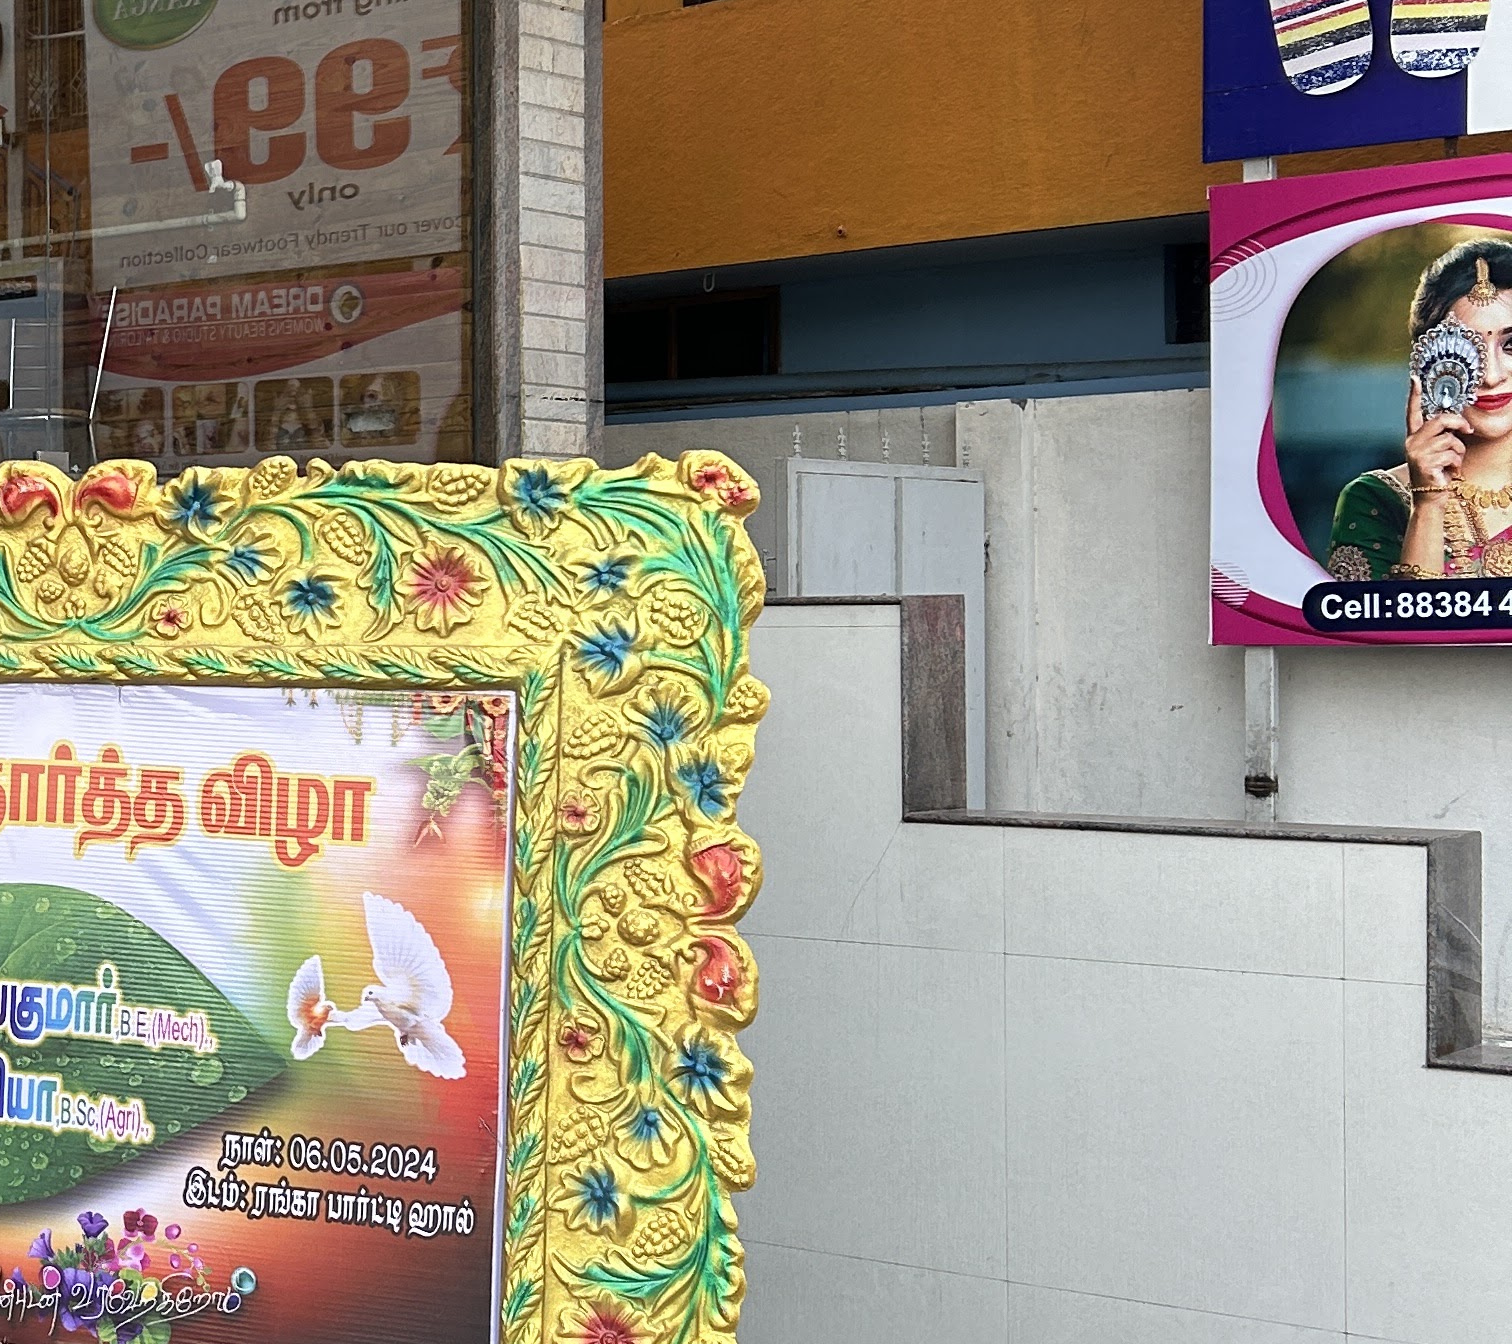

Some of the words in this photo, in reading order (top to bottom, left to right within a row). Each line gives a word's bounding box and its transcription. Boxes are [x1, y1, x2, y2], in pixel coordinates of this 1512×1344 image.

[202, 753, 373, 867] விழா
[290, 1136, 437, 1182] 06.05.2024
[251, 1180, 320, 1217] ரங்கா
[328, 1188, 402, 1233] பார்ட்டி
[408, 1200, 475, 1237] ஹால்
